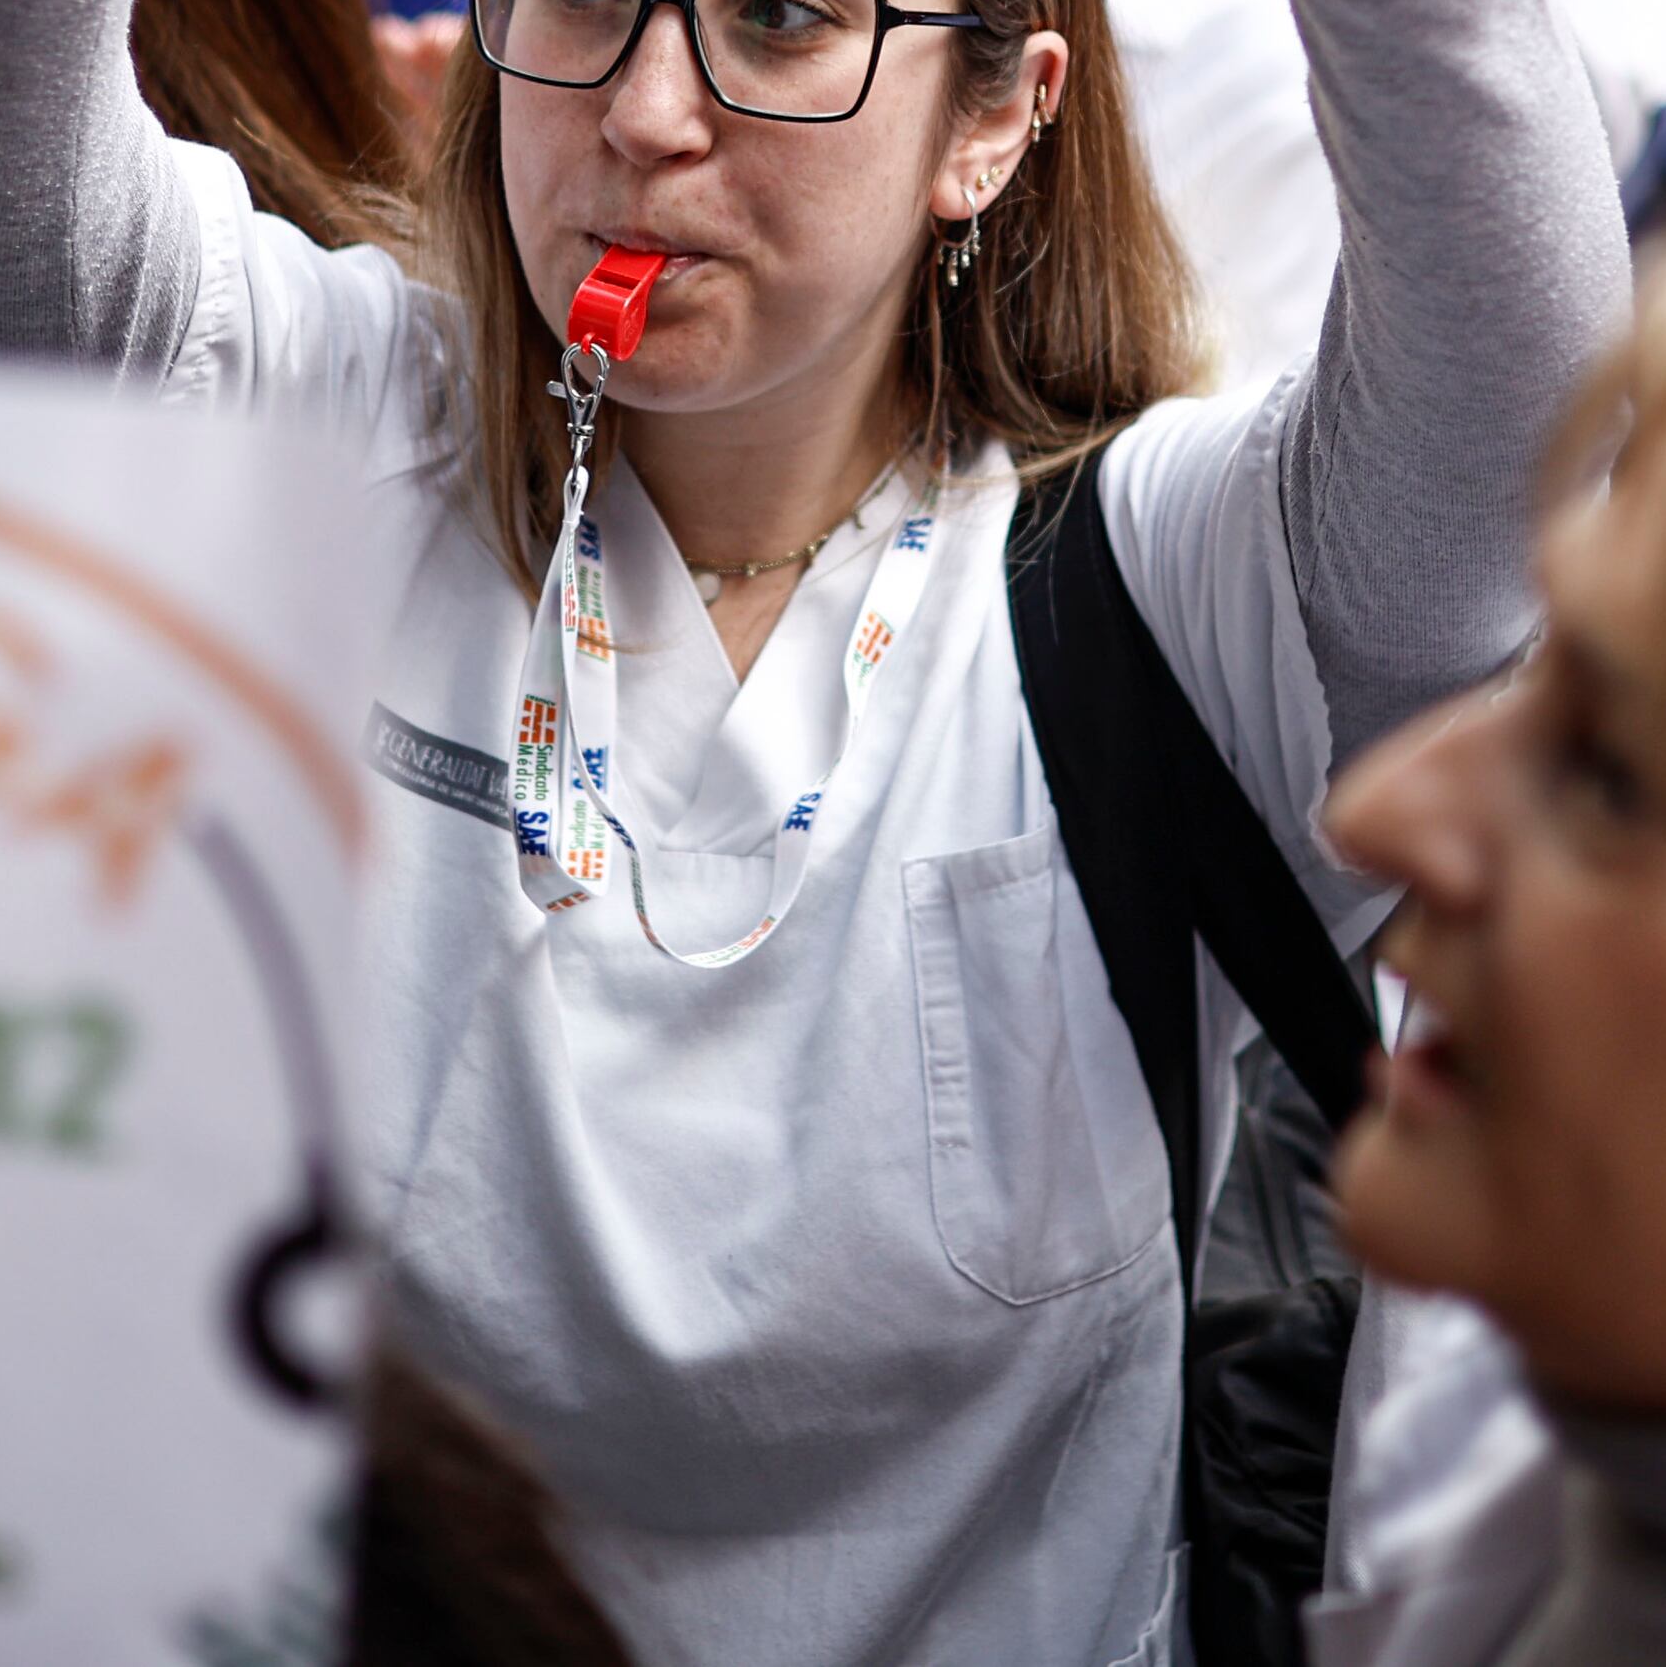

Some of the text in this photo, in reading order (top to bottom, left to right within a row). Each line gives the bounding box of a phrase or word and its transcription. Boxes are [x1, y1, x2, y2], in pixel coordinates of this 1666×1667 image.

[895, 517, 933, 552] SAE
[389, 731, 486, 788] GENERALITAT
[514, 745, 533, 800] Médico
[535, 745, 554, 801] Sindicato
[517, 811, 549, 856] SAE
[785, 792, 822, 831] SAE
